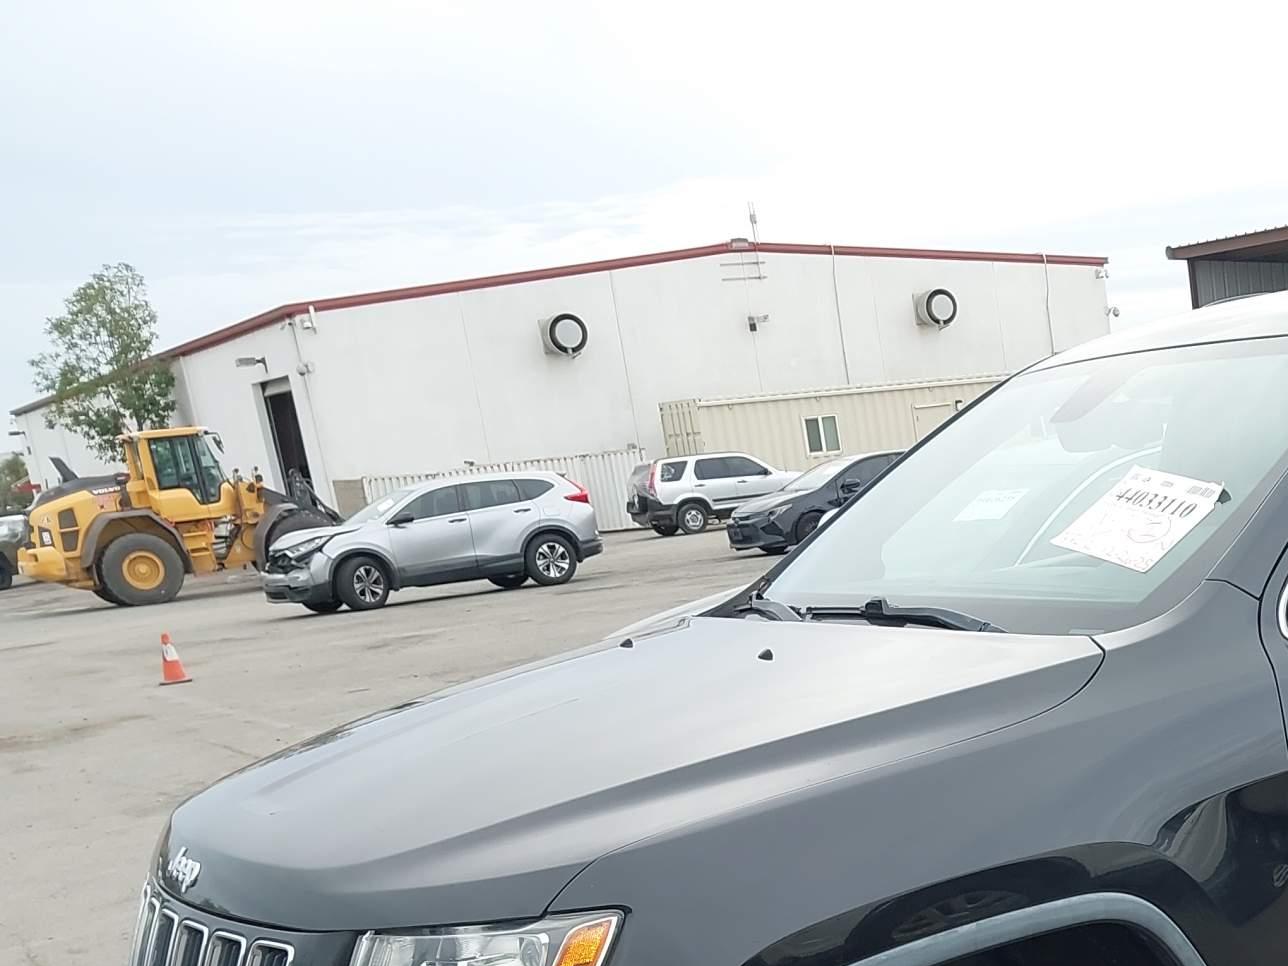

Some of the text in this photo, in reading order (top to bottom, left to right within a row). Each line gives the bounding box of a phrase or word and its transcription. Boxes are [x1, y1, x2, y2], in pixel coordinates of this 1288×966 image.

[92, 486, 120, 494] VOLVO
[1115, 487, 1198, 518] 44033110
[167, 846, 201, 893] Jeep
